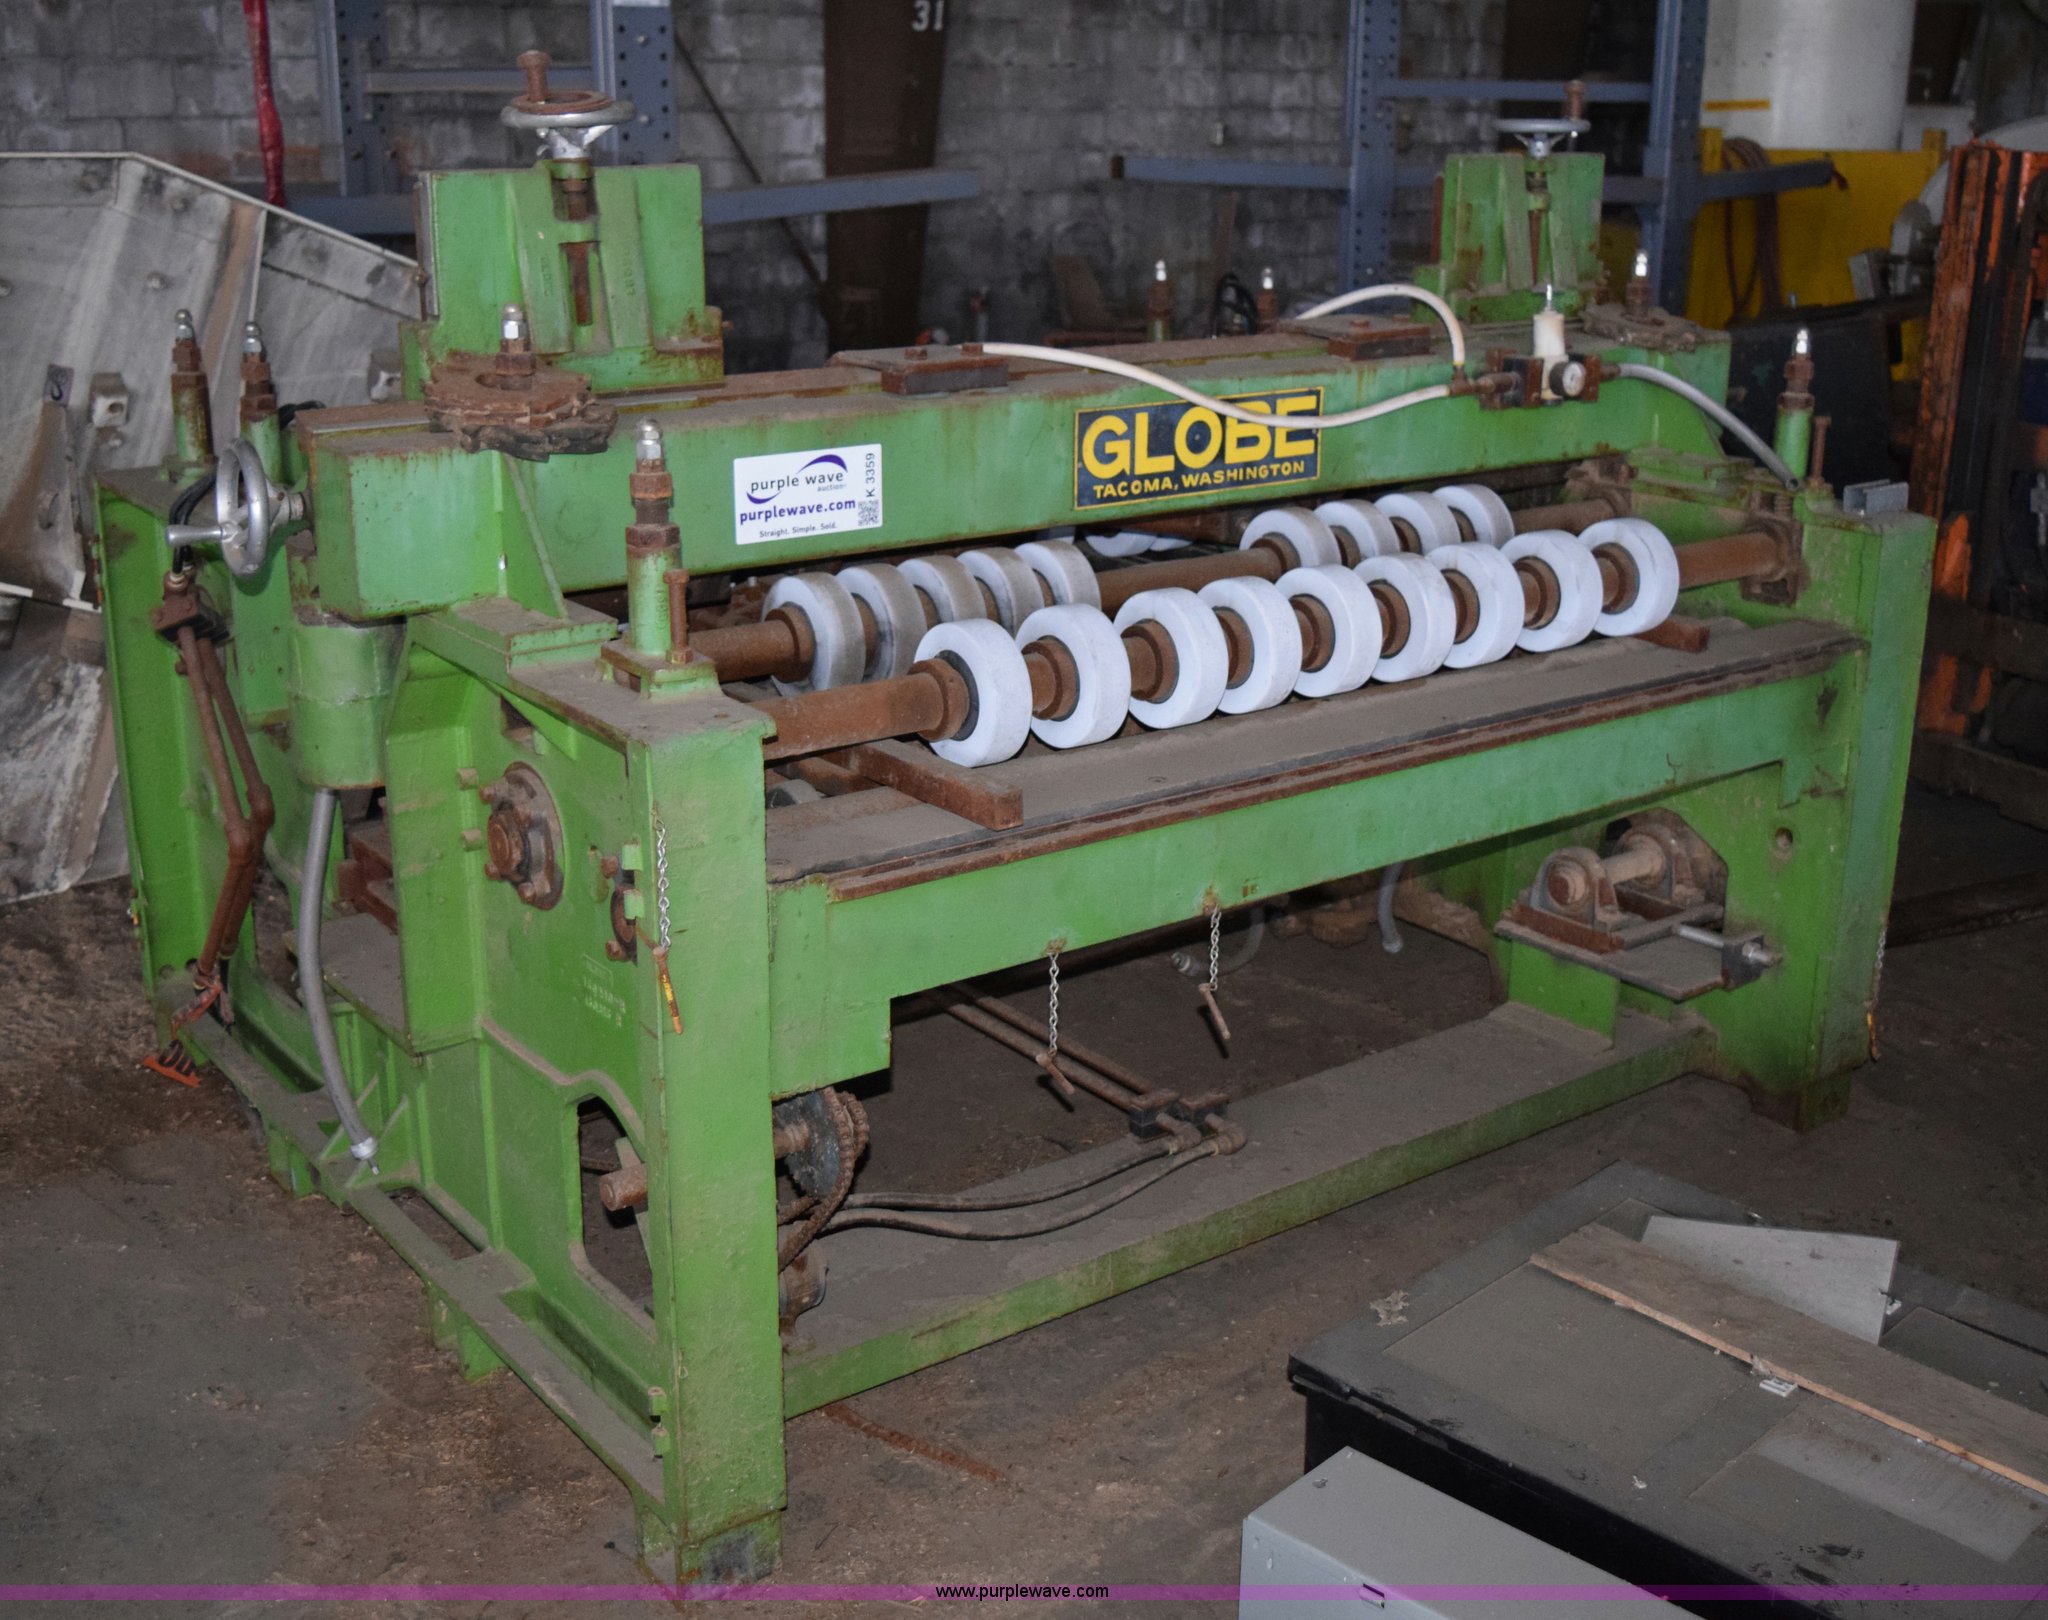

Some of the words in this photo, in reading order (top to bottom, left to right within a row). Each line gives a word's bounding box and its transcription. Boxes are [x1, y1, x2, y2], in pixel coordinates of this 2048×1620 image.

[912, 0, 945, 31] 31
[1082, 395, 1317, 479] GLOBE
[865, 452, 876, 485] 3359
[1093, 477, 1179, 499] TACOMA,
[1181, 461, 1305, 489] WASHINGTON
[750, 475, 799, 494] purple
[805, 472, 844, 485] wave
[865, 488, 876, 498] K
[740, 499, 856, 525] purplewave.com
[759, 528, 790, 538] Straight.
